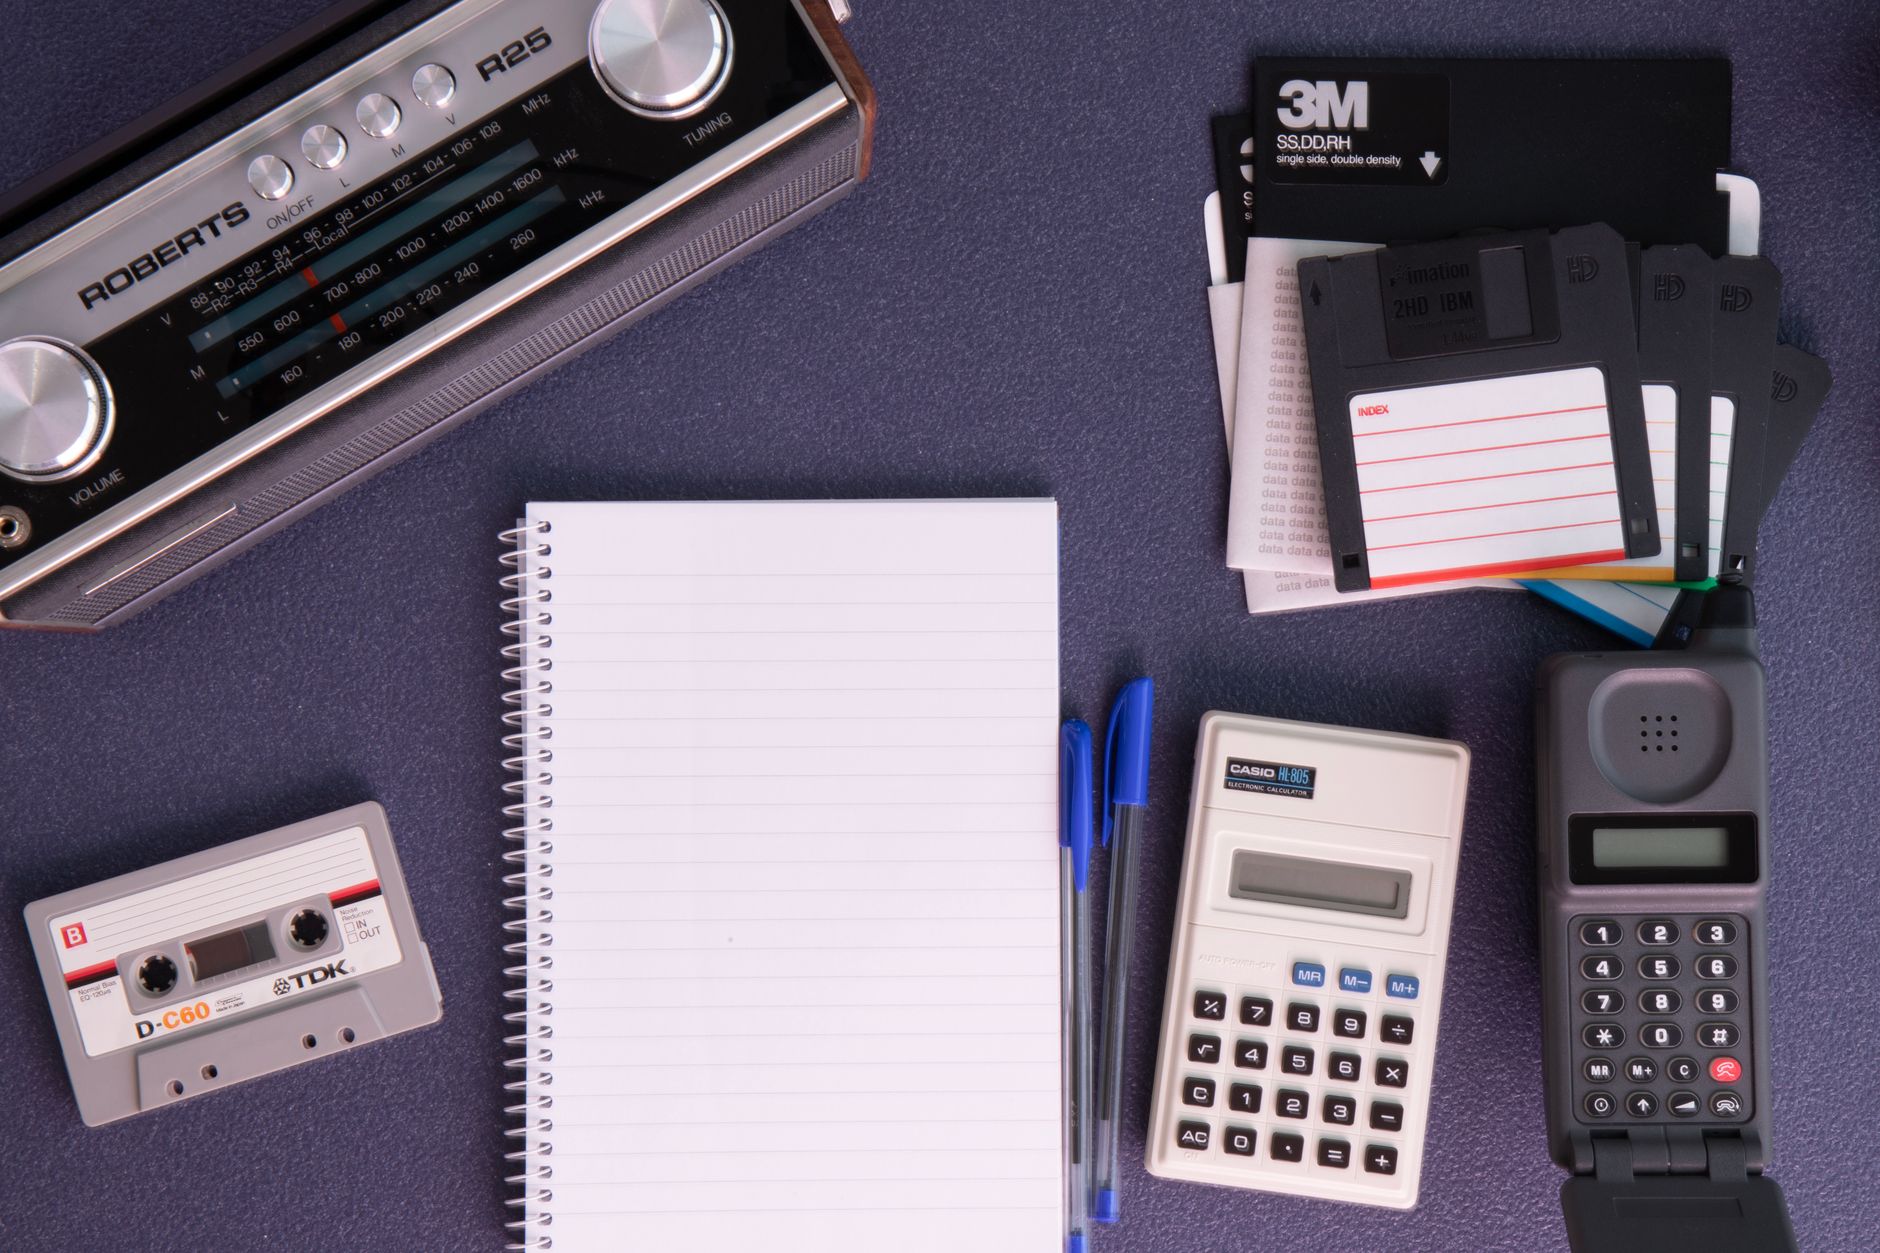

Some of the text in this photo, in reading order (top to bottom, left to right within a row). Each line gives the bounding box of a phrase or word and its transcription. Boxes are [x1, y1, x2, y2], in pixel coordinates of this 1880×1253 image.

[475, 26, 552, 82] R25
[1276, 79, 1369, 129] 3M
[444, 113, 456, 125] V
[682, 112, 733, 148] TUNING
[391, 144, 406, 158] M
[1276, 154, 1304, 166] single
[1330, 154, 1364, 164] double
[1366, 155, 1402, 167] density
[338, 178, 350, 188] L
[216, 277, 235, 294] 90
[244, 260, 263, 278] 92
[272, 245, 291, 262] 94
[303, 227, 321, 244] 96
[335, 208, 354, 225] 98
[361, 190, 383, 210] 100
[392, 174, 413, 193] 102
[422, 156, 444, 174] 104
[451, 138, 473, 158] 106
[479, 121, 501, 141] 108
[521, 92, 551, 116] MHz
[266, 194, 315, 231] ON/OFF
[77, 201, 250, 310] ROBERTS
[238, 147, 579, 352] 550 600 700 800 1000 1200 1400 1600 kHz
[1407, 262, 1470, 285] imation
[1566, 254, 1599, 285] HD
[280, 188, 606, 384] 160 180 200 220 240 260 kHz
[1653, 272, 1686, 301] HD
[1274, 294, 1300, 305] data
[1393, 290, 1474, 319] 2HD IBM
[1720, 284, 1753, 313] HD
[160, 312, 172, 326] V
[1273, 308, 1299, 319] data
[1272, 322, 1298, 332] data
[1271, 336, 1297, 346] data
[1270, 350, 1296, 360] data
[190, 364, 206, 380] M
[1269, 363, 1295, 374] data
[1269, 377, 1294, 388] data
[1268, 391, 1293, 402] data
[216, 410, 230, 422] L
[1267, 405, 1292, 416] data
[1358, 404, 1389, 417] INDEX
[1266, 419, 1291, 429] data
[1265, 433, 1290, 443] data
[1264, 447, 1318, 459] data data
[1263, 460, 1317, 473] data data
[68, 468, 126, 507] VOLUME
[1262, 474, 1316, 487] data data
[1261, 488, 1287, 499] data
[1290, 490, 1316, 500] data
[1260, 502, 1286, 512] data
[1289, 504, 1315, 514] data
[1259, 516, 1285, 526] data
[1289, 518, 1314, 528] data
[1258, 530, 1284, 540] data
[1288, 531, 1313, 542] data
[1257, 544, 1283, 554] data
[1287, 545, 1312, 556] data
[1276, 578, 1330, 592] data data
[1230, 764, 1275, 778] CASIO
[1228, 782, 1308, 797] ELECTRONIC CALCULATOR
[356, 918, 367, 930] IN
[66, 926, 82, 944] B
[359, 926, 382, 940] OUT
[1596, 926, 1724, 941] 1 2 3
[288, 958, 350, 990] TDK
[1596, 960, 1724, 975] 4 5 6
[1298, 970, 1321, 982] MR
[1392, 981, 1416, 993] M+
[1597, 994, 1724, 1010] 7 8 9
[135, 1000, 210, 1039] D-C60
[1251, 1006, 1264, 1019] 7
[1298, 1012, 1312, 1025] 8
[1344, 1018, 1358, 1031] 9
[1656, 1028, 1668, 1043] 0
[1244, 1048, 1258, 1061] 4
[1292, 1055, 1306, 1068] 5
[1339, 1062, 1352, 1074] 6
[1590, 1065, 1608, 1076] MR
[1680, 1064, 1689, 1076] C
[1193, 1086, 1208, 1100] C
[1242, 1093, 1250, 1105] 1
[1286, 1099, 1301, 1112] 2
[1333, 1105, 1347, 1118] 3
[1182, 1130, 1208, 1144] AC
[1234, 1136, 1248, 1148] 0
